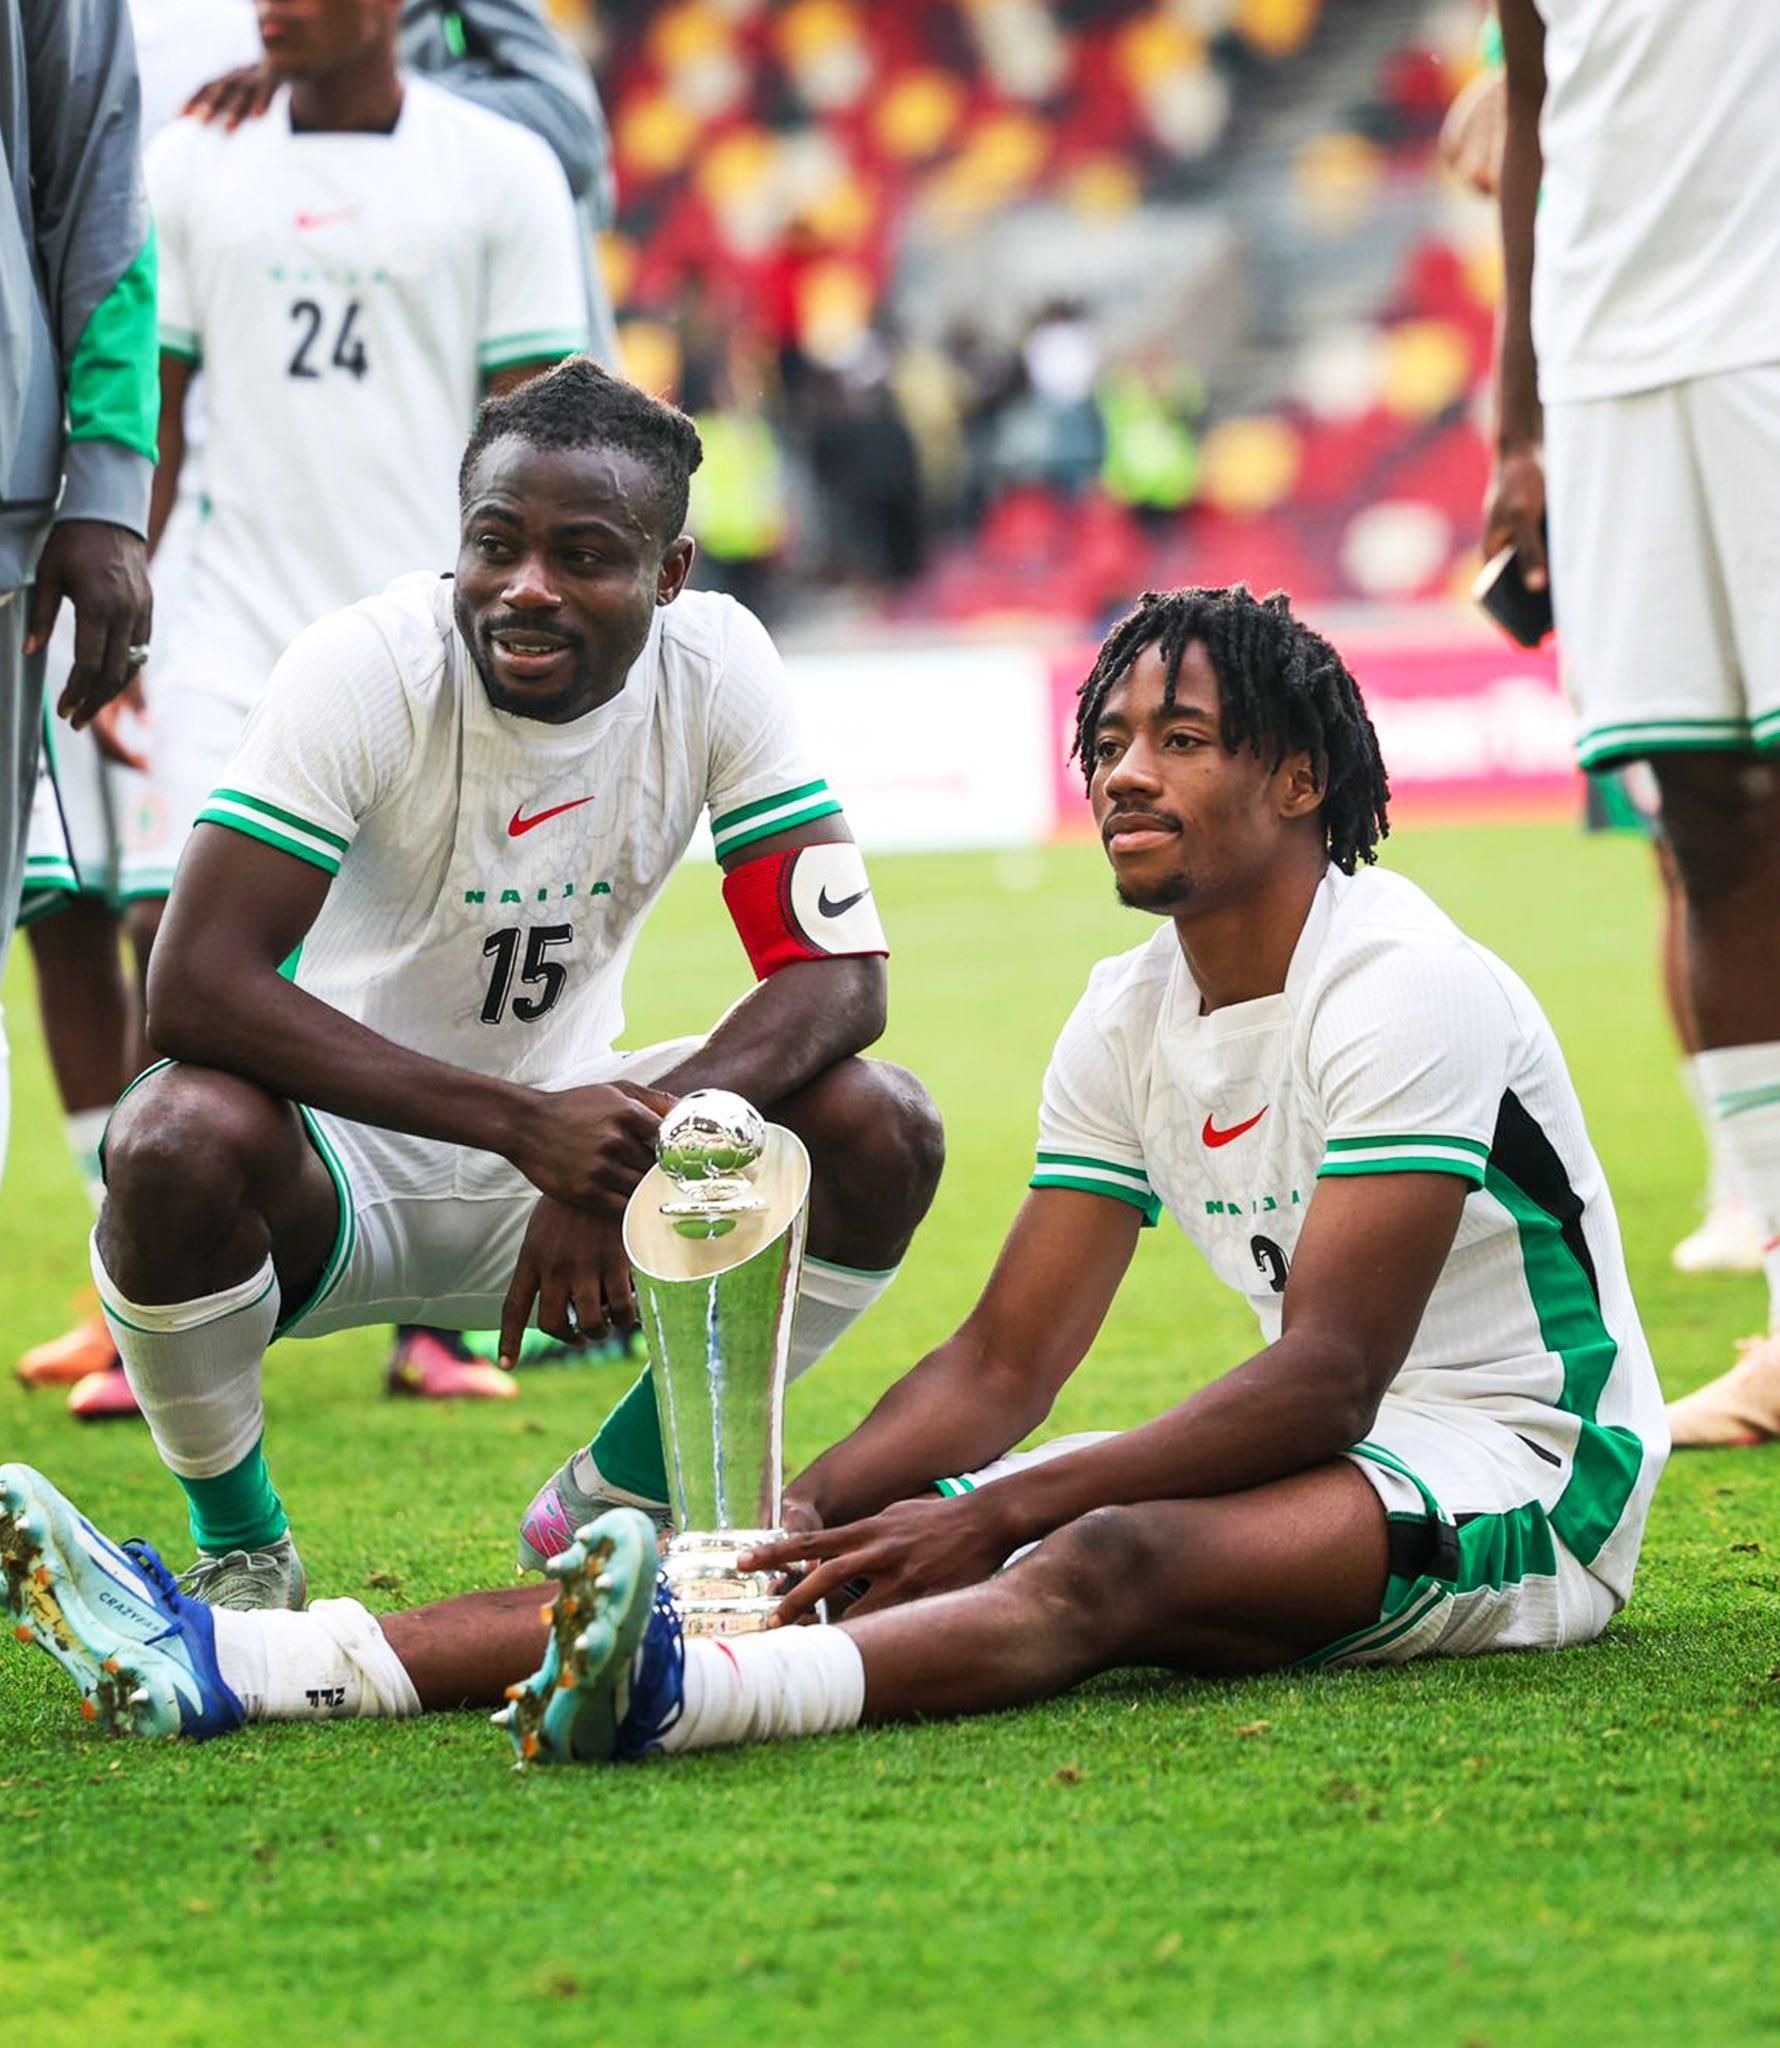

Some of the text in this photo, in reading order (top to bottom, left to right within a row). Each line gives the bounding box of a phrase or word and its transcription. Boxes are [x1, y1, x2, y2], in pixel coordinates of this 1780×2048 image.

[288, 301, 368, 381] 24
[464, 881, 612, 904] NAIJA
[480, 922, 574, 1025] 15
